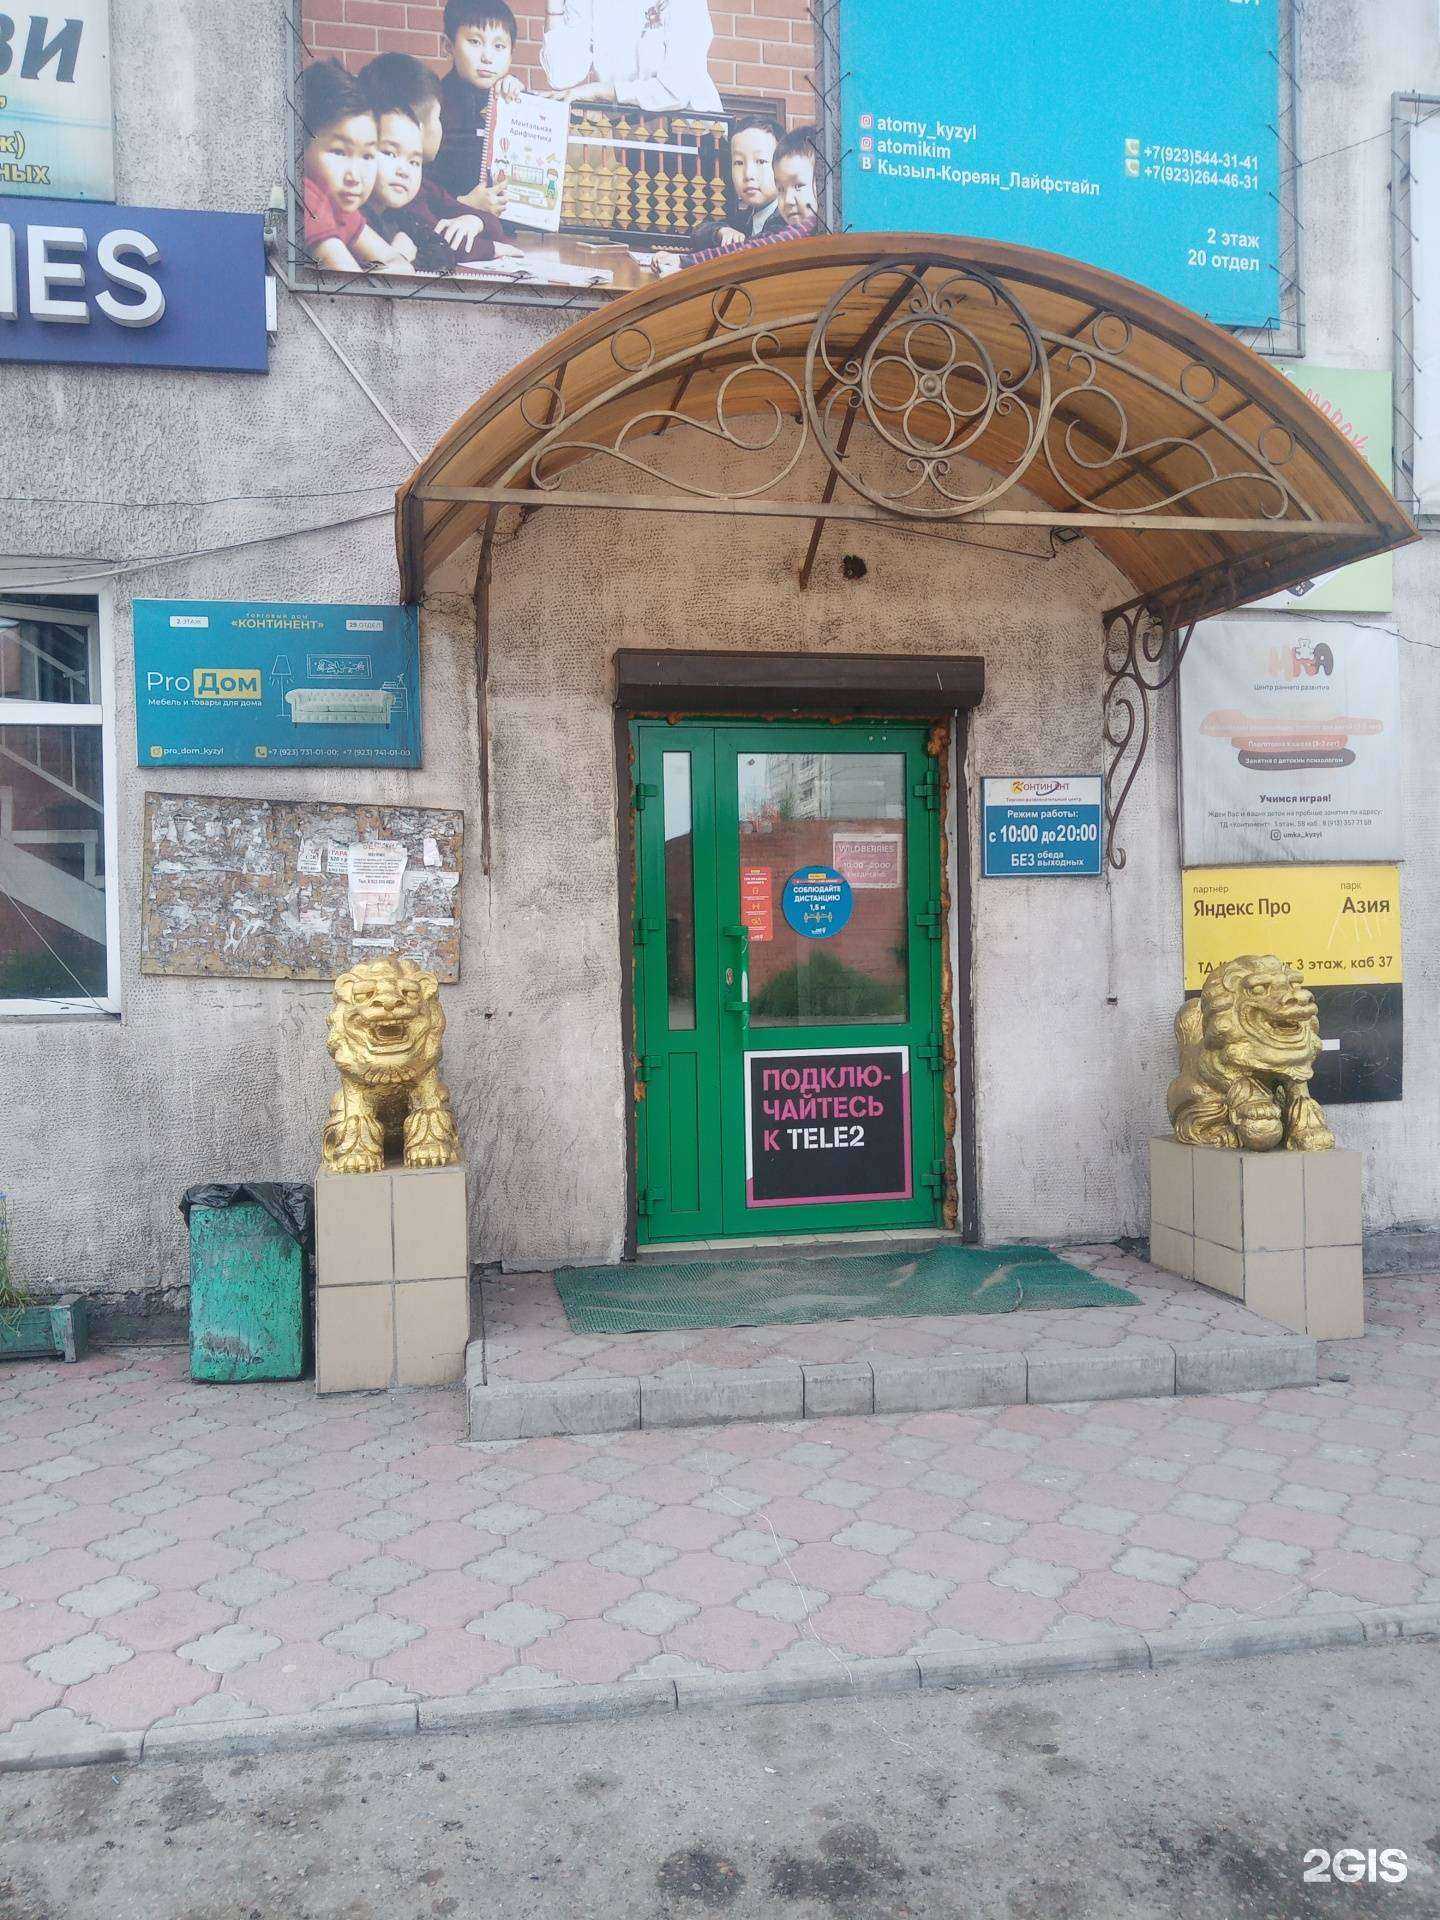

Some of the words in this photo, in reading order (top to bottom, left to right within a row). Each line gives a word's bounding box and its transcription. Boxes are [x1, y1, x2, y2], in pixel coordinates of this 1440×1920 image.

[877, 117, 977, 143] atomy_kyzyl
[877, 138, 951, 159] atomikim
[1144, 145, 1258, 170] +7(923)544-31-41
[878, 158, 1100, 196] Кызыл-Кореян_Лайфстайл
[1144, 165, 1258, 190] +7(923)264-46-31
[1207, 228, 1217, 244] 2
[1221, 232, 1260, 248] этаж
[1187, 249, 1207, 266] 20
[1211, 255, 1260, 272] отдел
[231, 618, 325, 631] «КОНТИНЕНТ»
[147, 672, 191, 692] Pro
[198, 672, 258, 695] Дом
[148, 698, 182, 706] Мебель
[191, 700, 222, 708] товары
[163, 746, 224, 756] pro_dom_kyzyl
[1259, 794, 1298, 804] Учимся
[1299, 794, 1332, 804] играя!
[1007, 809, 1039, 819] Режим
[1040, 809, 1079, 820] работы:
[988, 831, 997, 843] с
[1000, 824, 1039, 843] 10:00
[1041, 831, 1056, 844] до
[1056, 823, 1098, 842] 20:00
[1011, 853, 1036, 867] БЕЗ
[1037, 851, 1064, 859] обеда
[1037, 858, 1085, 867] выходных
[793, 885, 842, 893] СОБЛЮДАЙТЕ
[1340, 881, 1361, 891] парк
[794, 894, 841, 903] ДИСТАНЦИЮ
[1193, 899, 1254, 918] Яндекс
[1258, 898, 1291, 918] Про
[1342, 896, 1391, 914] Азия
[1296, 959, 1304, 971] 3
[1350, 956, 1375, 969] каб
[1378, 955, 1393, 967] 37
[763, 1065, 891, 1093] ПОДКЛЮ-
[763, 1092, 884, 1121] ЧАЙТЕСЬ
[763, 1129, 781, 1151] К
[787, 1125, 865, 1150] TELE2
